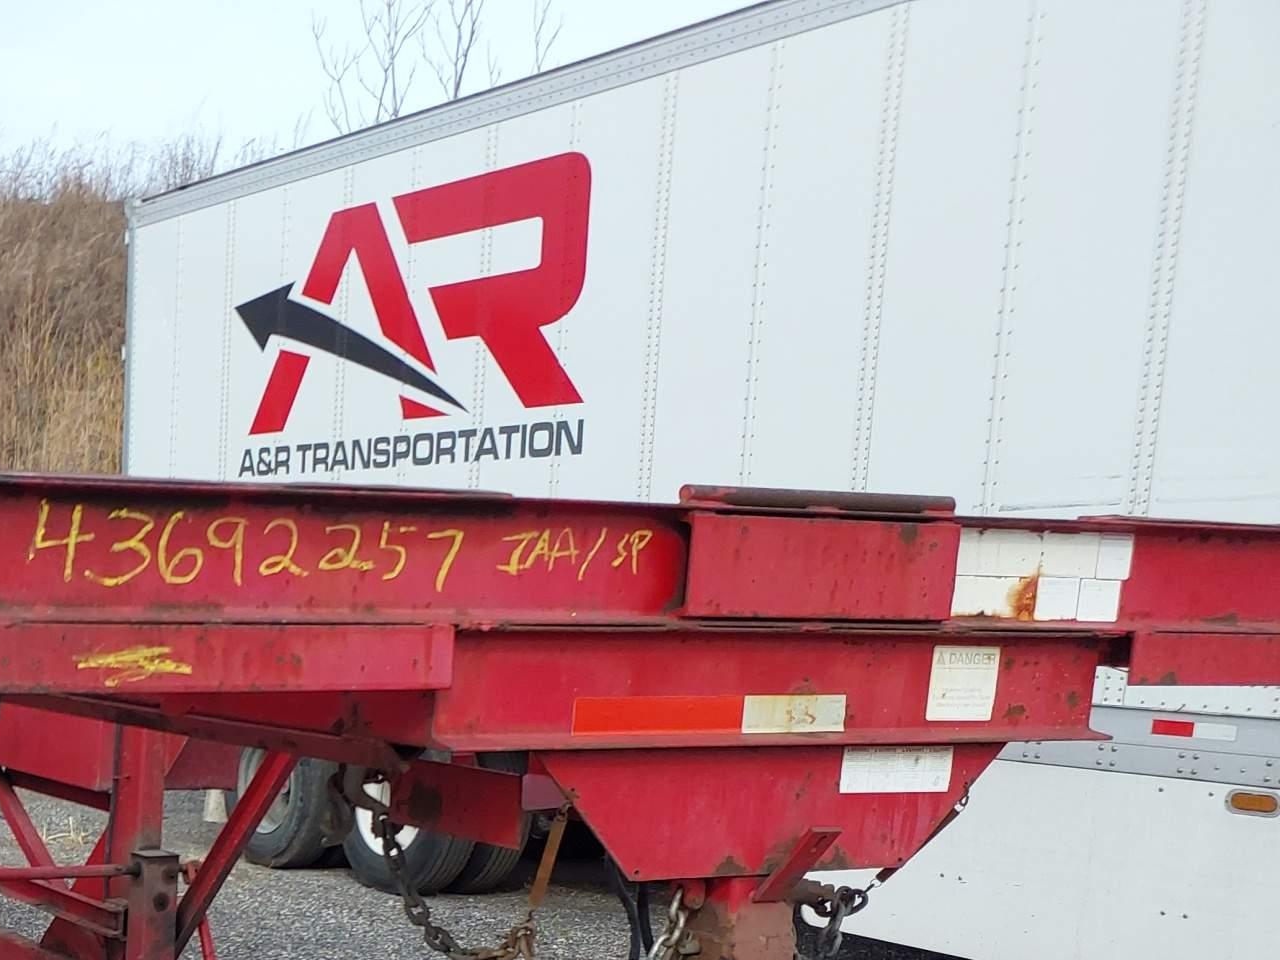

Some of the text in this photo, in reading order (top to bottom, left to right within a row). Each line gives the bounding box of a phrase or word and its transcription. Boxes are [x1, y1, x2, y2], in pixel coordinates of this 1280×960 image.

[238, 419, 585, 478] A&R TRANSPORTATION
[27, 499, 463, 591] 43692257
[949, 652, 996, 665] DANGER
